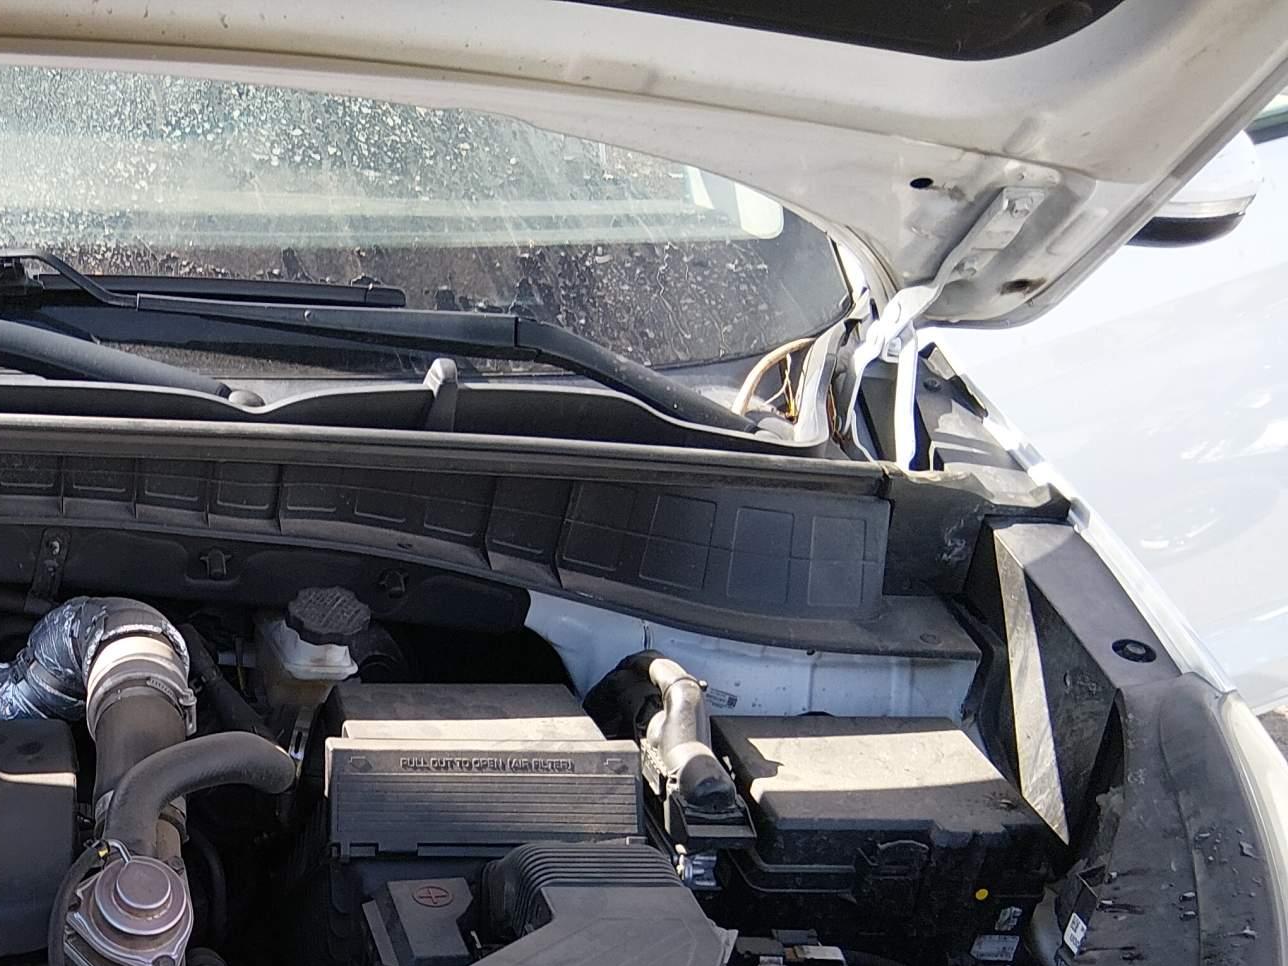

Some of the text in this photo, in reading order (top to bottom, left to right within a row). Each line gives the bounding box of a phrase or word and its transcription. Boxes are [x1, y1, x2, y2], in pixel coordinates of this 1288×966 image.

[400, 757, 429, 769] PULL
[430, 757, 452, 769] OUT
[455, 757, 470, 769] TO
[472, 757, 502, 769] OPEN
